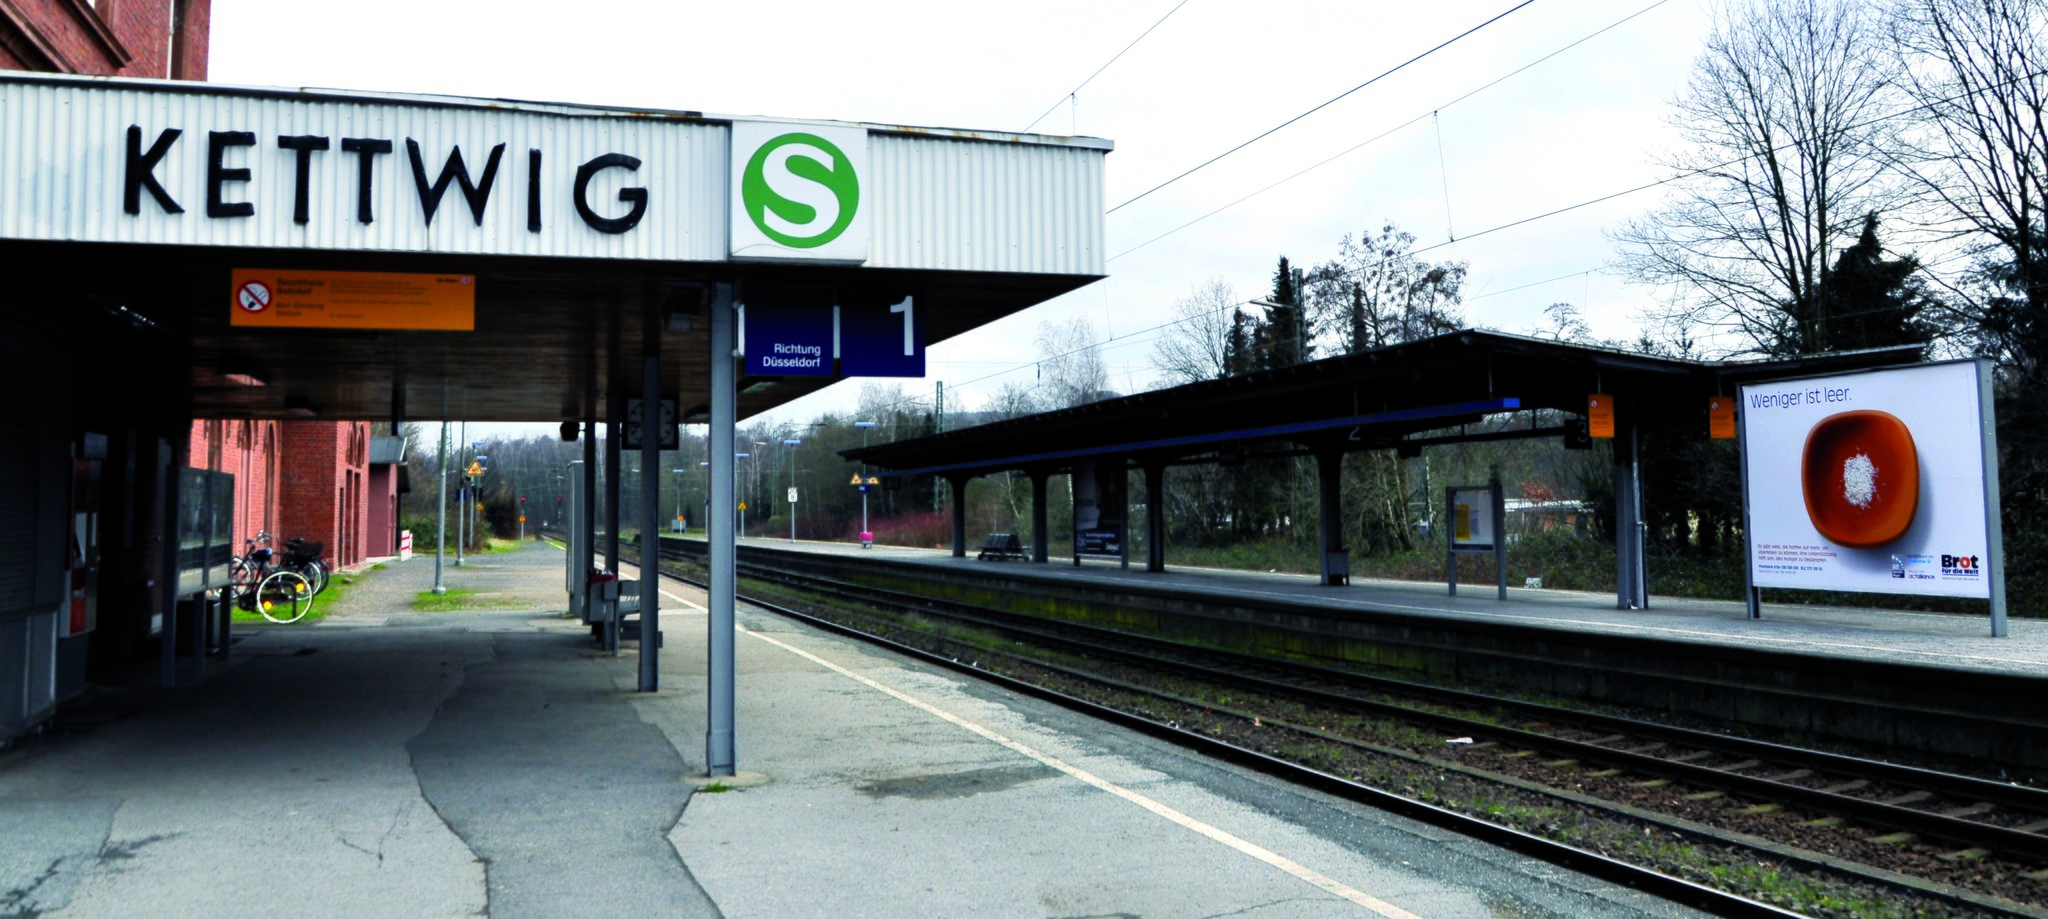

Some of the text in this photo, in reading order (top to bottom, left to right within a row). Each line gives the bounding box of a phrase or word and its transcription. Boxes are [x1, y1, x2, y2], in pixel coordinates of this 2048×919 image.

[123, 124, 648, 235] KETTWIG
[762, 142, 841, 239] S
[890, 295, 914, 356] 1
[774, 343, 821, 356] Richtung
[763, 356, 821, 367] Düsseldorf
[1750, 386, 1852, 409] Weniger ist leer.
[1576, 421, 1589, 443] 3
[1941, 554, 1979, 569] Brot
